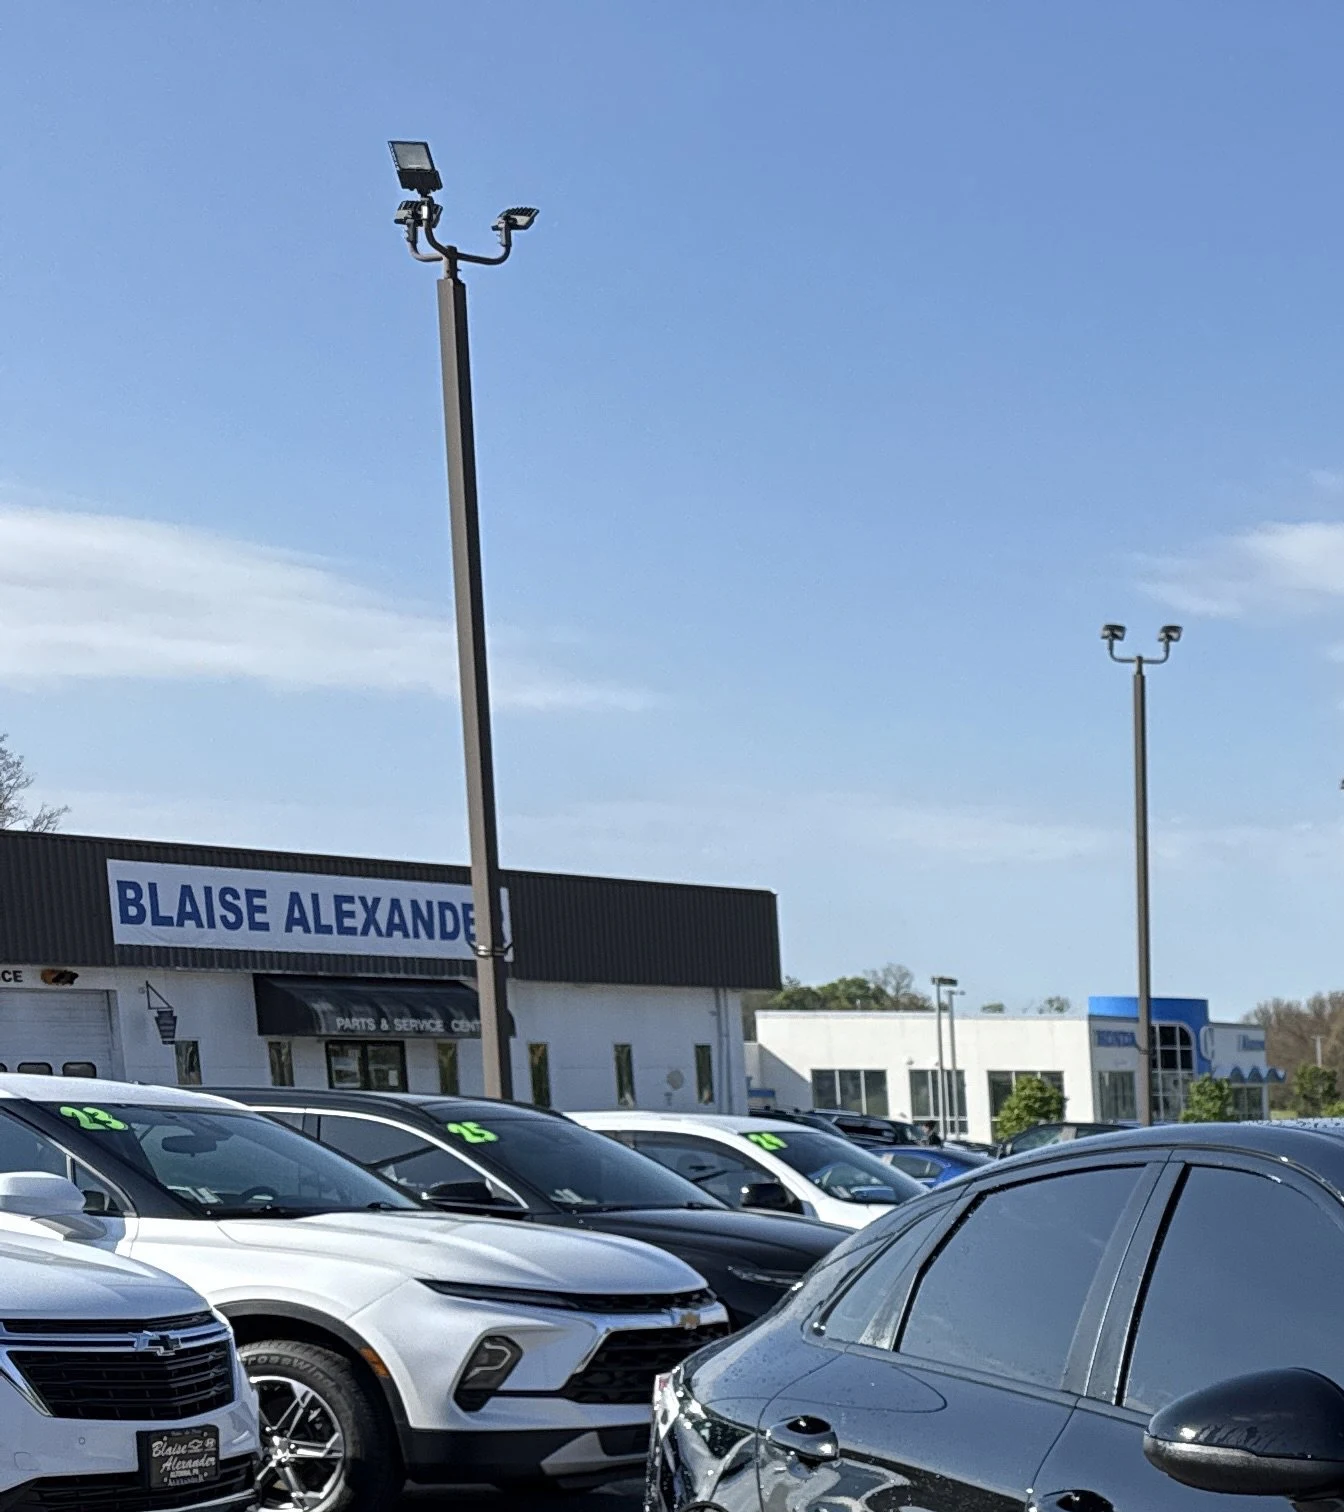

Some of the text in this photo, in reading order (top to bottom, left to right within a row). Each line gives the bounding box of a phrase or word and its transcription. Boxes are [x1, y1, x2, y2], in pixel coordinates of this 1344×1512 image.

[116, 879, 510, 945] BLAISE ALEXANDE
[336, 1017, 481, 1032] PARTS & SERVICE CENT
[60, 1106, 129, 1131] 23
[446, 1121, 500, 1144] 25
[152, 1440, 187, 1458] Blaise
[160, 1453, 216, 1474] Alexander
